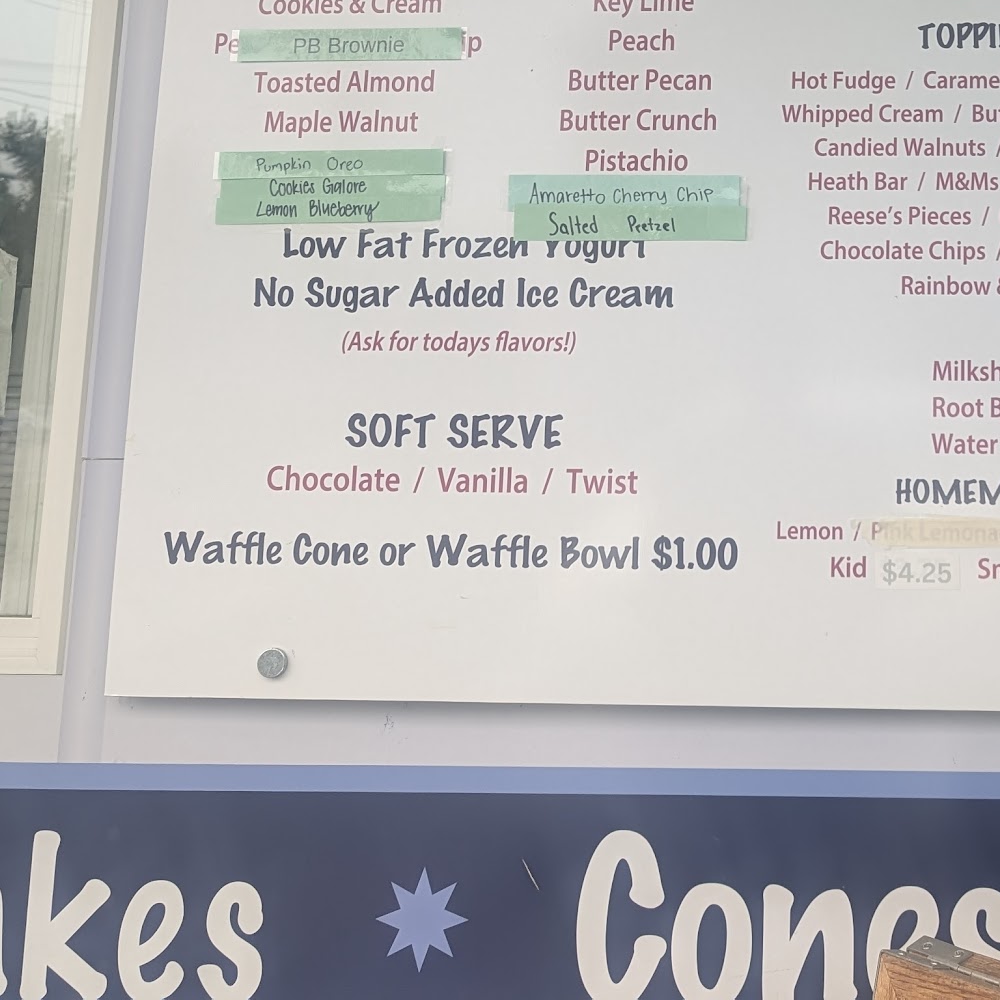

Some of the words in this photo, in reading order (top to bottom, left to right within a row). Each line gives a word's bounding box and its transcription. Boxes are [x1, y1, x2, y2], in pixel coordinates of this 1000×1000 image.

[294, 38, 320, 54] PB
[329, 36, 404, 53] Brownie
[609, 29, 674, 51] Peach
[792, 72, 827, 89] Hot
[834, 71, 895, 94] Fudge
[265, 110, 332, 138] Maple
[339, 110, 418, 132] Walnut
[782, 104, 872, 127] Whipped
[879, 105, 943, 122] Cream
[815, 137, 897, 156] Candied
[904, 137, 985, 156] Walnuts
[256, 157, 311, 174] Pumpkin
[327, 157, 363, 171] Oreo
[586, 148, 688, 171] Pistachio
[270, 179, 315, 196] Cookies
[323, 178, 367, 194] Galore
[529, 182, 605, 204] Amaretto
[613, 188, 667, 205] Cherry
[677, 187, 713, 202] Chip
[256, 201, 297, 217] Lemon
[309, 200, 380, 222] Blueberry
[909, 206, 971, 225] Pieces
[549, 212, 598, 236] Salted
[627, 215, 675, 233] Pretzel
[283, 228, 347, 258] Low
[357, 229, 412, 258] Fat
[422, 229, 528, 259] Frozen
[545, 240, 648, 263] Yogurt
[254, 277, 294, 307] No
[305, 277, 399, 313] Sugar
[409, 277, 504, 307] Added
[517, 278, 558, 307] Ice
[570, 277, 673, 308] Cream
[902, 275, 991, 295] Rainbow
[342, 331, 385, 354] (Ask
[389, 330, 418, 351] for
[424, 331, 490, 357] todays
[496, 331, 576, 354] flavors!)
[933, 397, 983, 417] Root
[345, 413, 436, 448] SOFT
[447, 414, 563, 449] SERVE
[932, 434, 998, 454] Water
[267, 465, 400, 492] Chocolate
[438, 467, 527, 493] Vanilla
[566, 469, 638, 494] Twist
[777, 521, 842, 540] Lemon
[164, 531, 282, 565] Waffle
[293, 533, 368, 566] Cone
[380, 543, 416, 566] or
[426, 534, 548, 568] Waffle
[561, 536, 639, 569] Bowl
[651, 535, 738, 571] $1.00
[831, 556, 866, 578] Kid
[883, 559, 951, 585] $4.25
[0, 829, 263, 1000] kes
